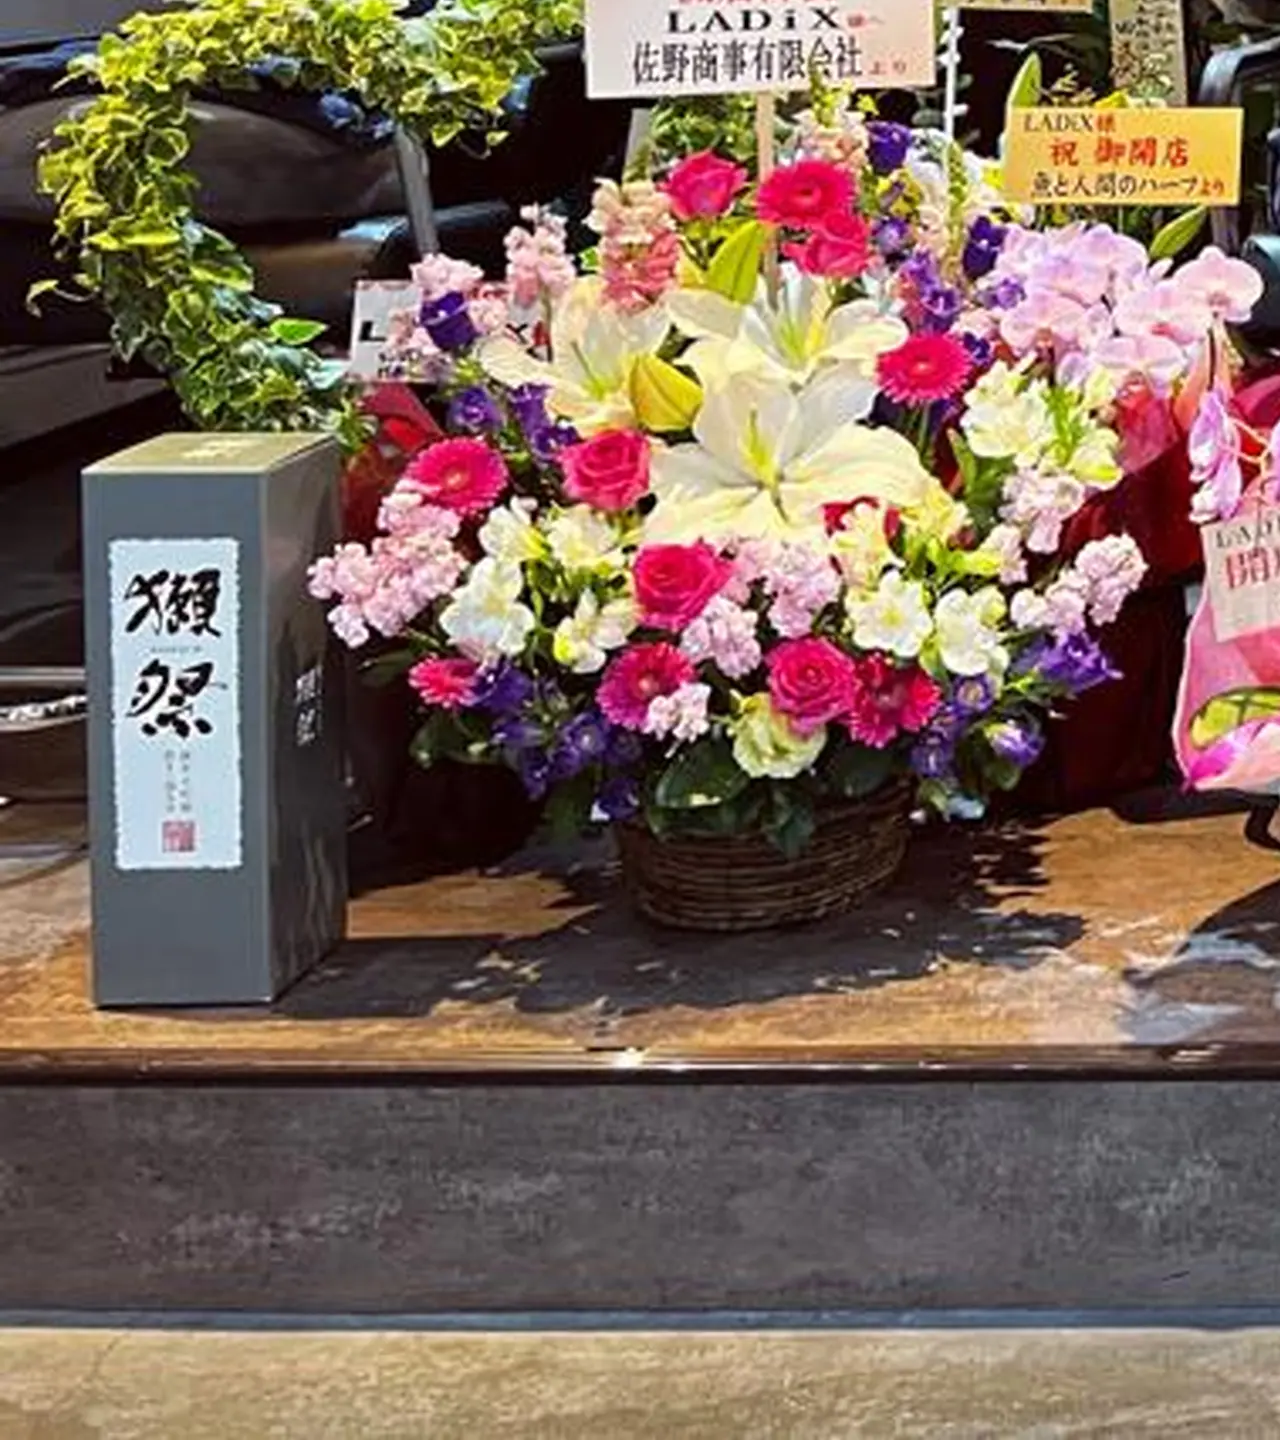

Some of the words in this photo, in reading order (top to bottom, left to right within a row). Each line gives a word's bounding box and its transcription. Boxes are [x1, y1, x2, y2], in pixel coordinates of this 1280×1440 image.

[667, 6, 840, 34] LADiX
[633, 34, 864, 86] 佐野商事有限会社
[1050, 138, 1079, 167] 祝
[1094, 136, 1189, 168] 御開店
